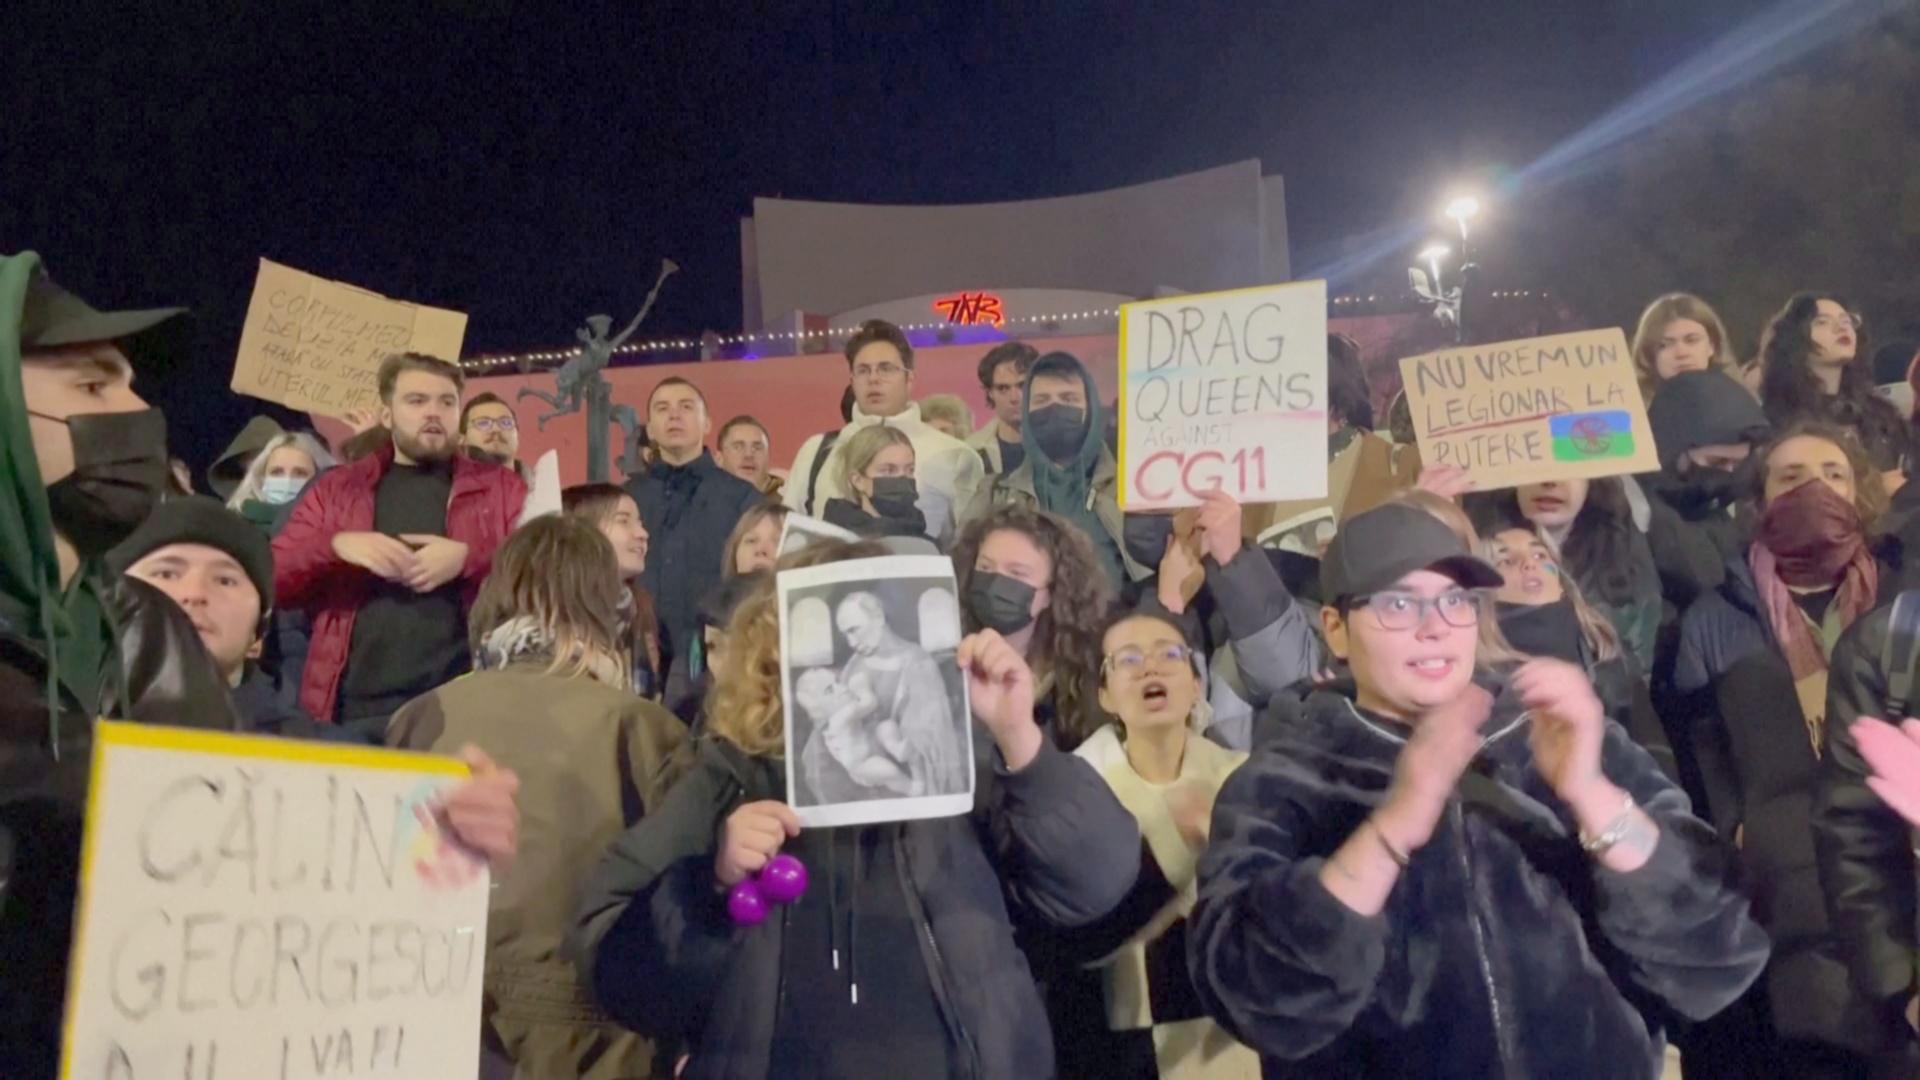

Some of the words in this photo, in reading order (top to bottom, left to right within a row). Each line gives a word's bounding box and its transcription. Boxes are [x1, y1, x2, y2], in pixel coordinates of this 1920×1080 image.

[1144, 303, 1285, 373] DRAG
[1415, 355, 1467, 397] NU
[1474, 345, 1570, 383] VREM
[1574, 343, 1619, 369] UN
[1135, 372, 1315, 423] QUEENS
[1426, 386, 1575, 434] LEGIONAR
[1586, 381, 1626, 406] LA
[1143, 423, 1236, 447] AGAINST
[1433, 430, 1544, 471] PUTERE
[1134, 445, 1267, 501] CG11
[109, 906, 475, 1022] GEORGESCU
